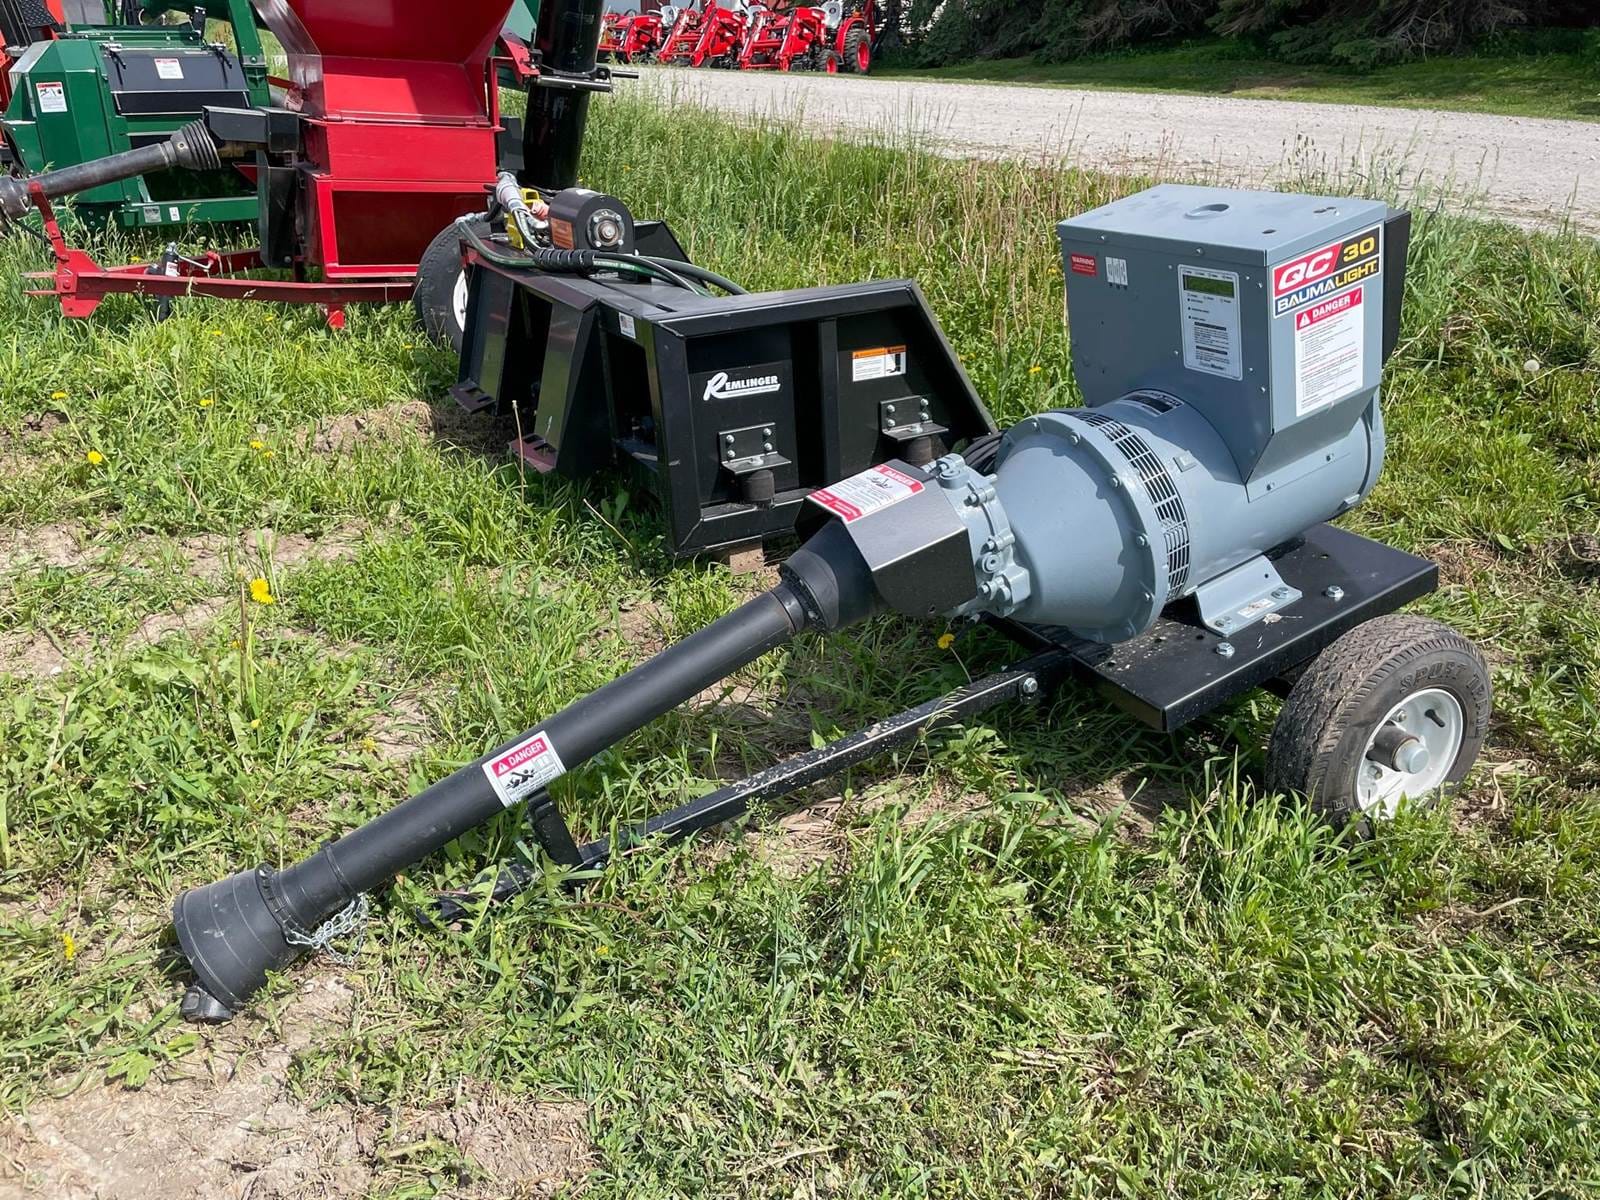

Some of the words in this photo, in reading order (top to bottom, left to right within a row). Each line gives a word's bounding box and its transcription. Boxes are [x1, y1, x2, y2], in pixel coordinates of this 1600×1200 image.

[1278, 250, 1333, 291] QC
[1343, 236, 1374, 263] 30
[1277, 259, 1377, 312] BAUMALIGHT
[1312, 295, 1351, 318] DANGER
[703, 372, 779, 401] REMLINGER
[884, 470, 916, 486] DANGER
[508, 740, 544, 765] DANGER
